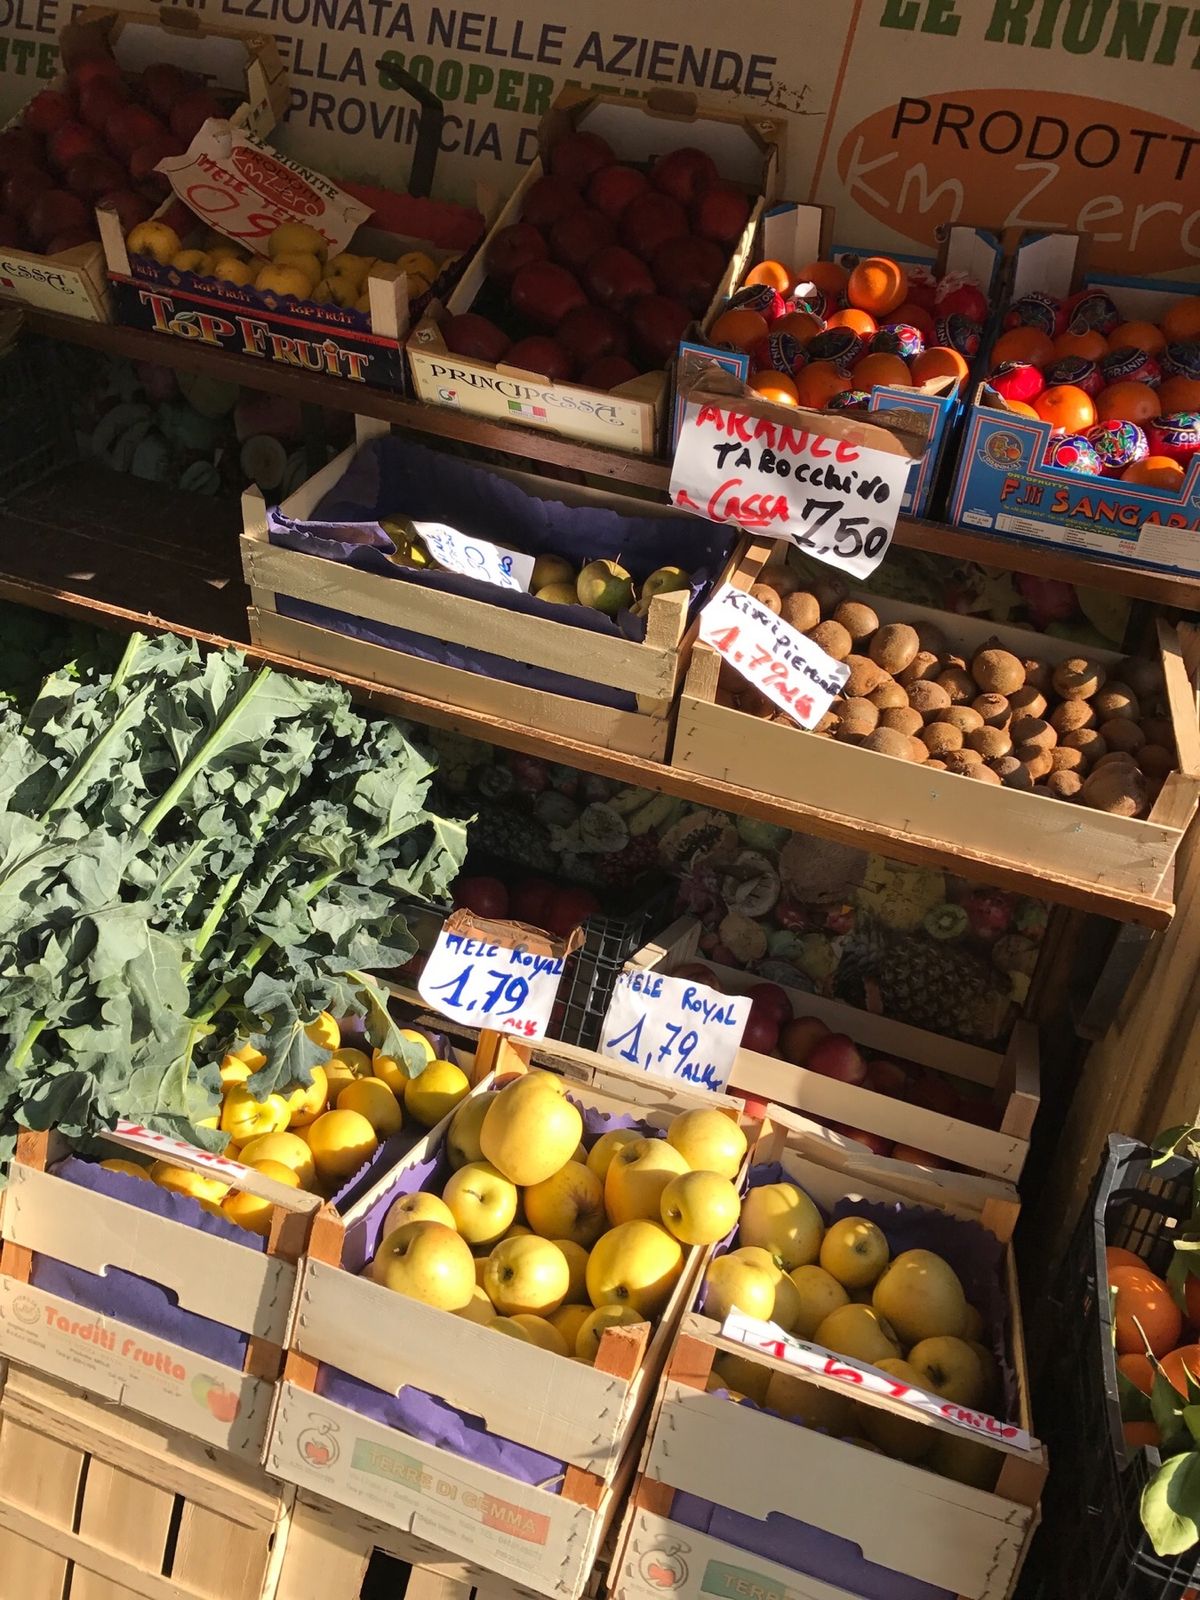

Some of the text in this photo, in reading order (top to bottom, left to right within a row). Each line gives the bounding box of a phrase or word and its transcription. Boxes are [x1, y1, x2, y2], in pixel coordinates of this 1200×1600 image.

[427, 7, 566, 65] NELLE
[574, 31, 777, 97] AZIENDE
[431, 364, 625, 427] PRINCIPESSA
[1007, 471, 1070, 490] ORTOFRUTTA
[791, 498, 888, 559] 7,50
[509, 944, 564, 981] ROYAL
[681, 986, 737, 1025] ROYAL
[606, 1012, 699, 1074] 1,79
[45, 1305, 117, 1351] Tarditi
[368, 1451, 434, 1490] TERRE
[436, 1479, 459, 1501] DI
[462, 1490, 537, 1534] GEMMA
[724, 1572, 798, 1600] TERR
